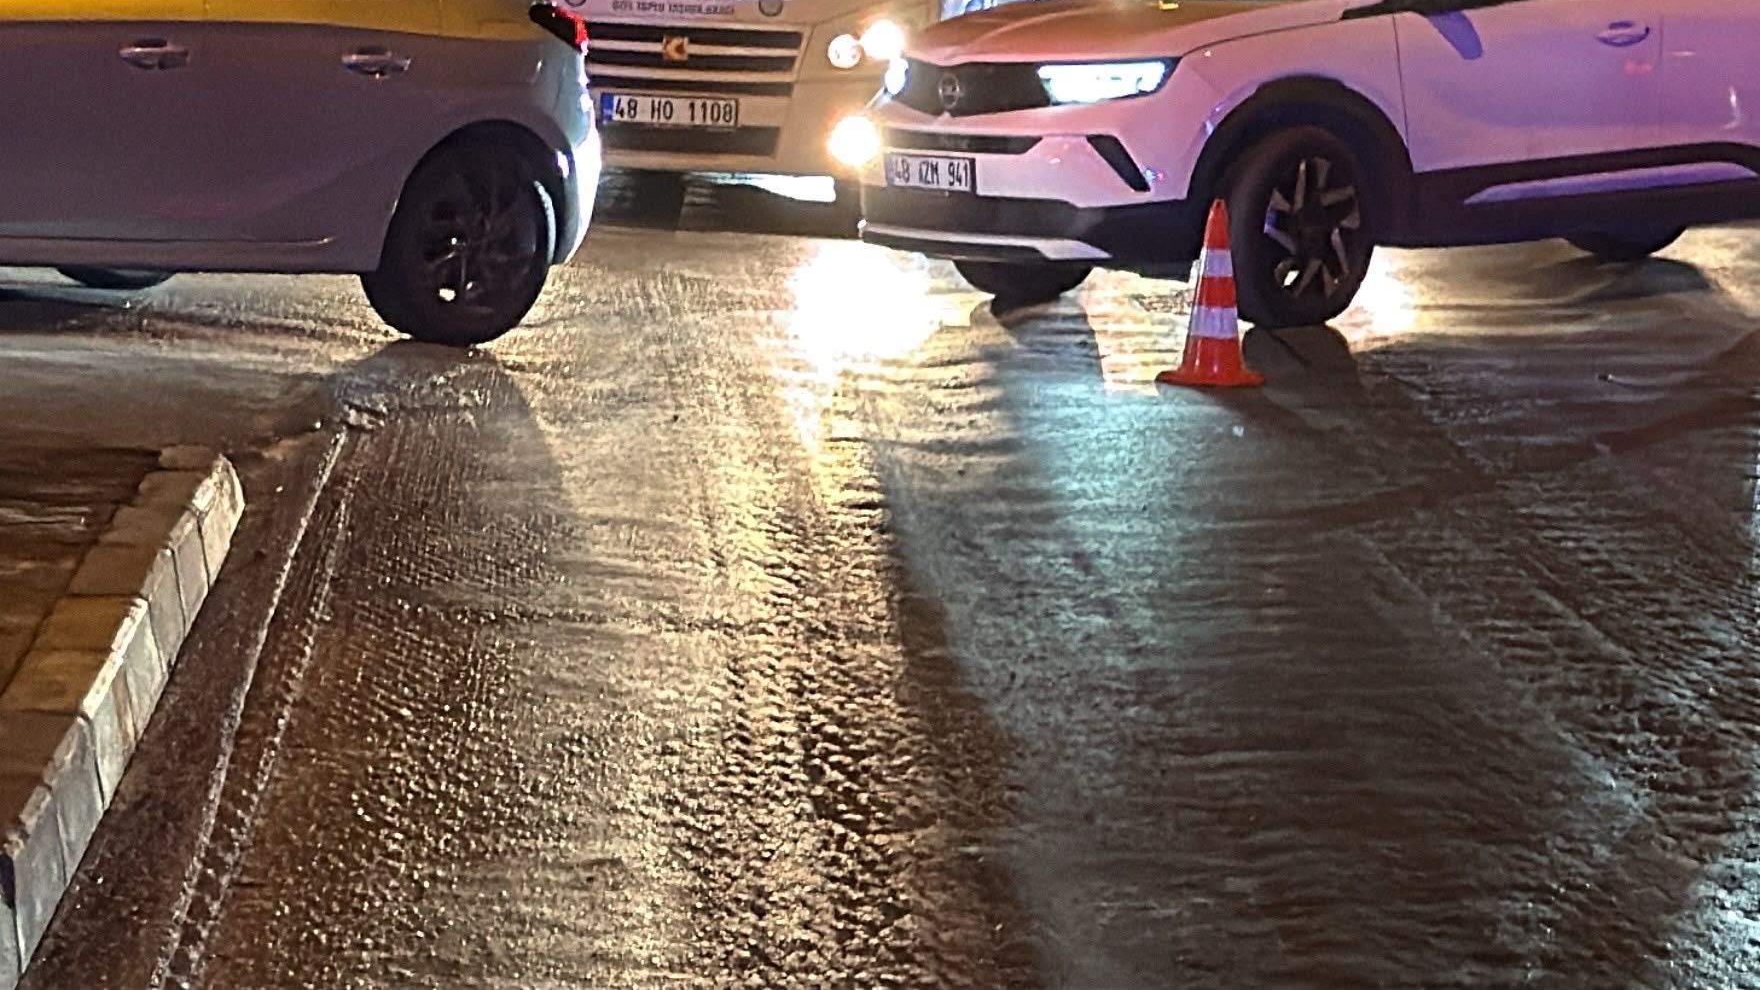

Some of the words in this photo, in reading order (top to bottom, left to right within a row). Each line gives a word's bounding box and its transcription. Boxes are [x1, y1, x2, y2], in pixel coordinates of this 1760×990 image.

[615, 97, 638, 119] 48
[650, 98, 674, 121] HO
[688, 101, 733, 123] 1108
[894, 157, 910, 183] 48
[948, 161, 968, 188] 941
